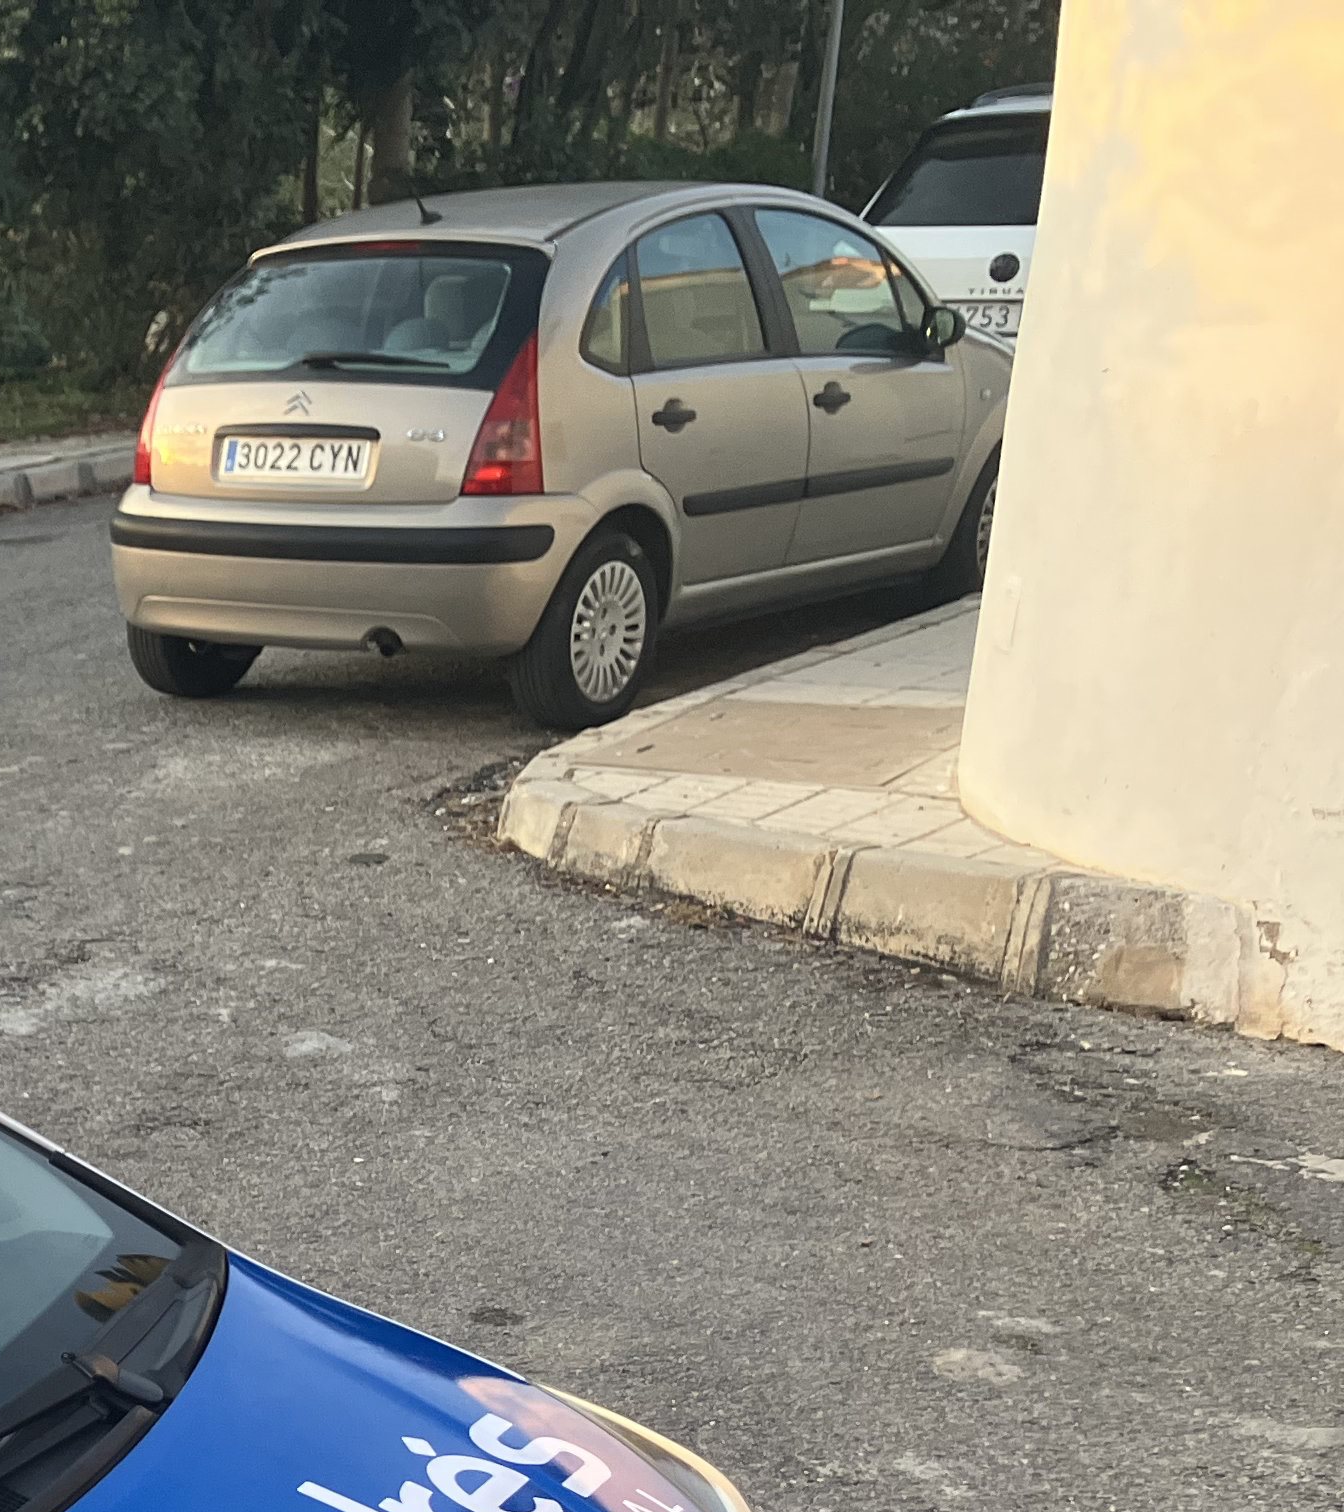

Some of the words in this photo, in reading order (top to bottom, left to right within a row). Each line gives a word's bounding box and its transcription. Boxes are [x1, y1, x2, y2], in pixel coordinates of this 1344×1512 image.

[957, 304, 1010, 328] 753
[238, 442, 302, 471] 3022
[310, 443, 361, 473] CYN
